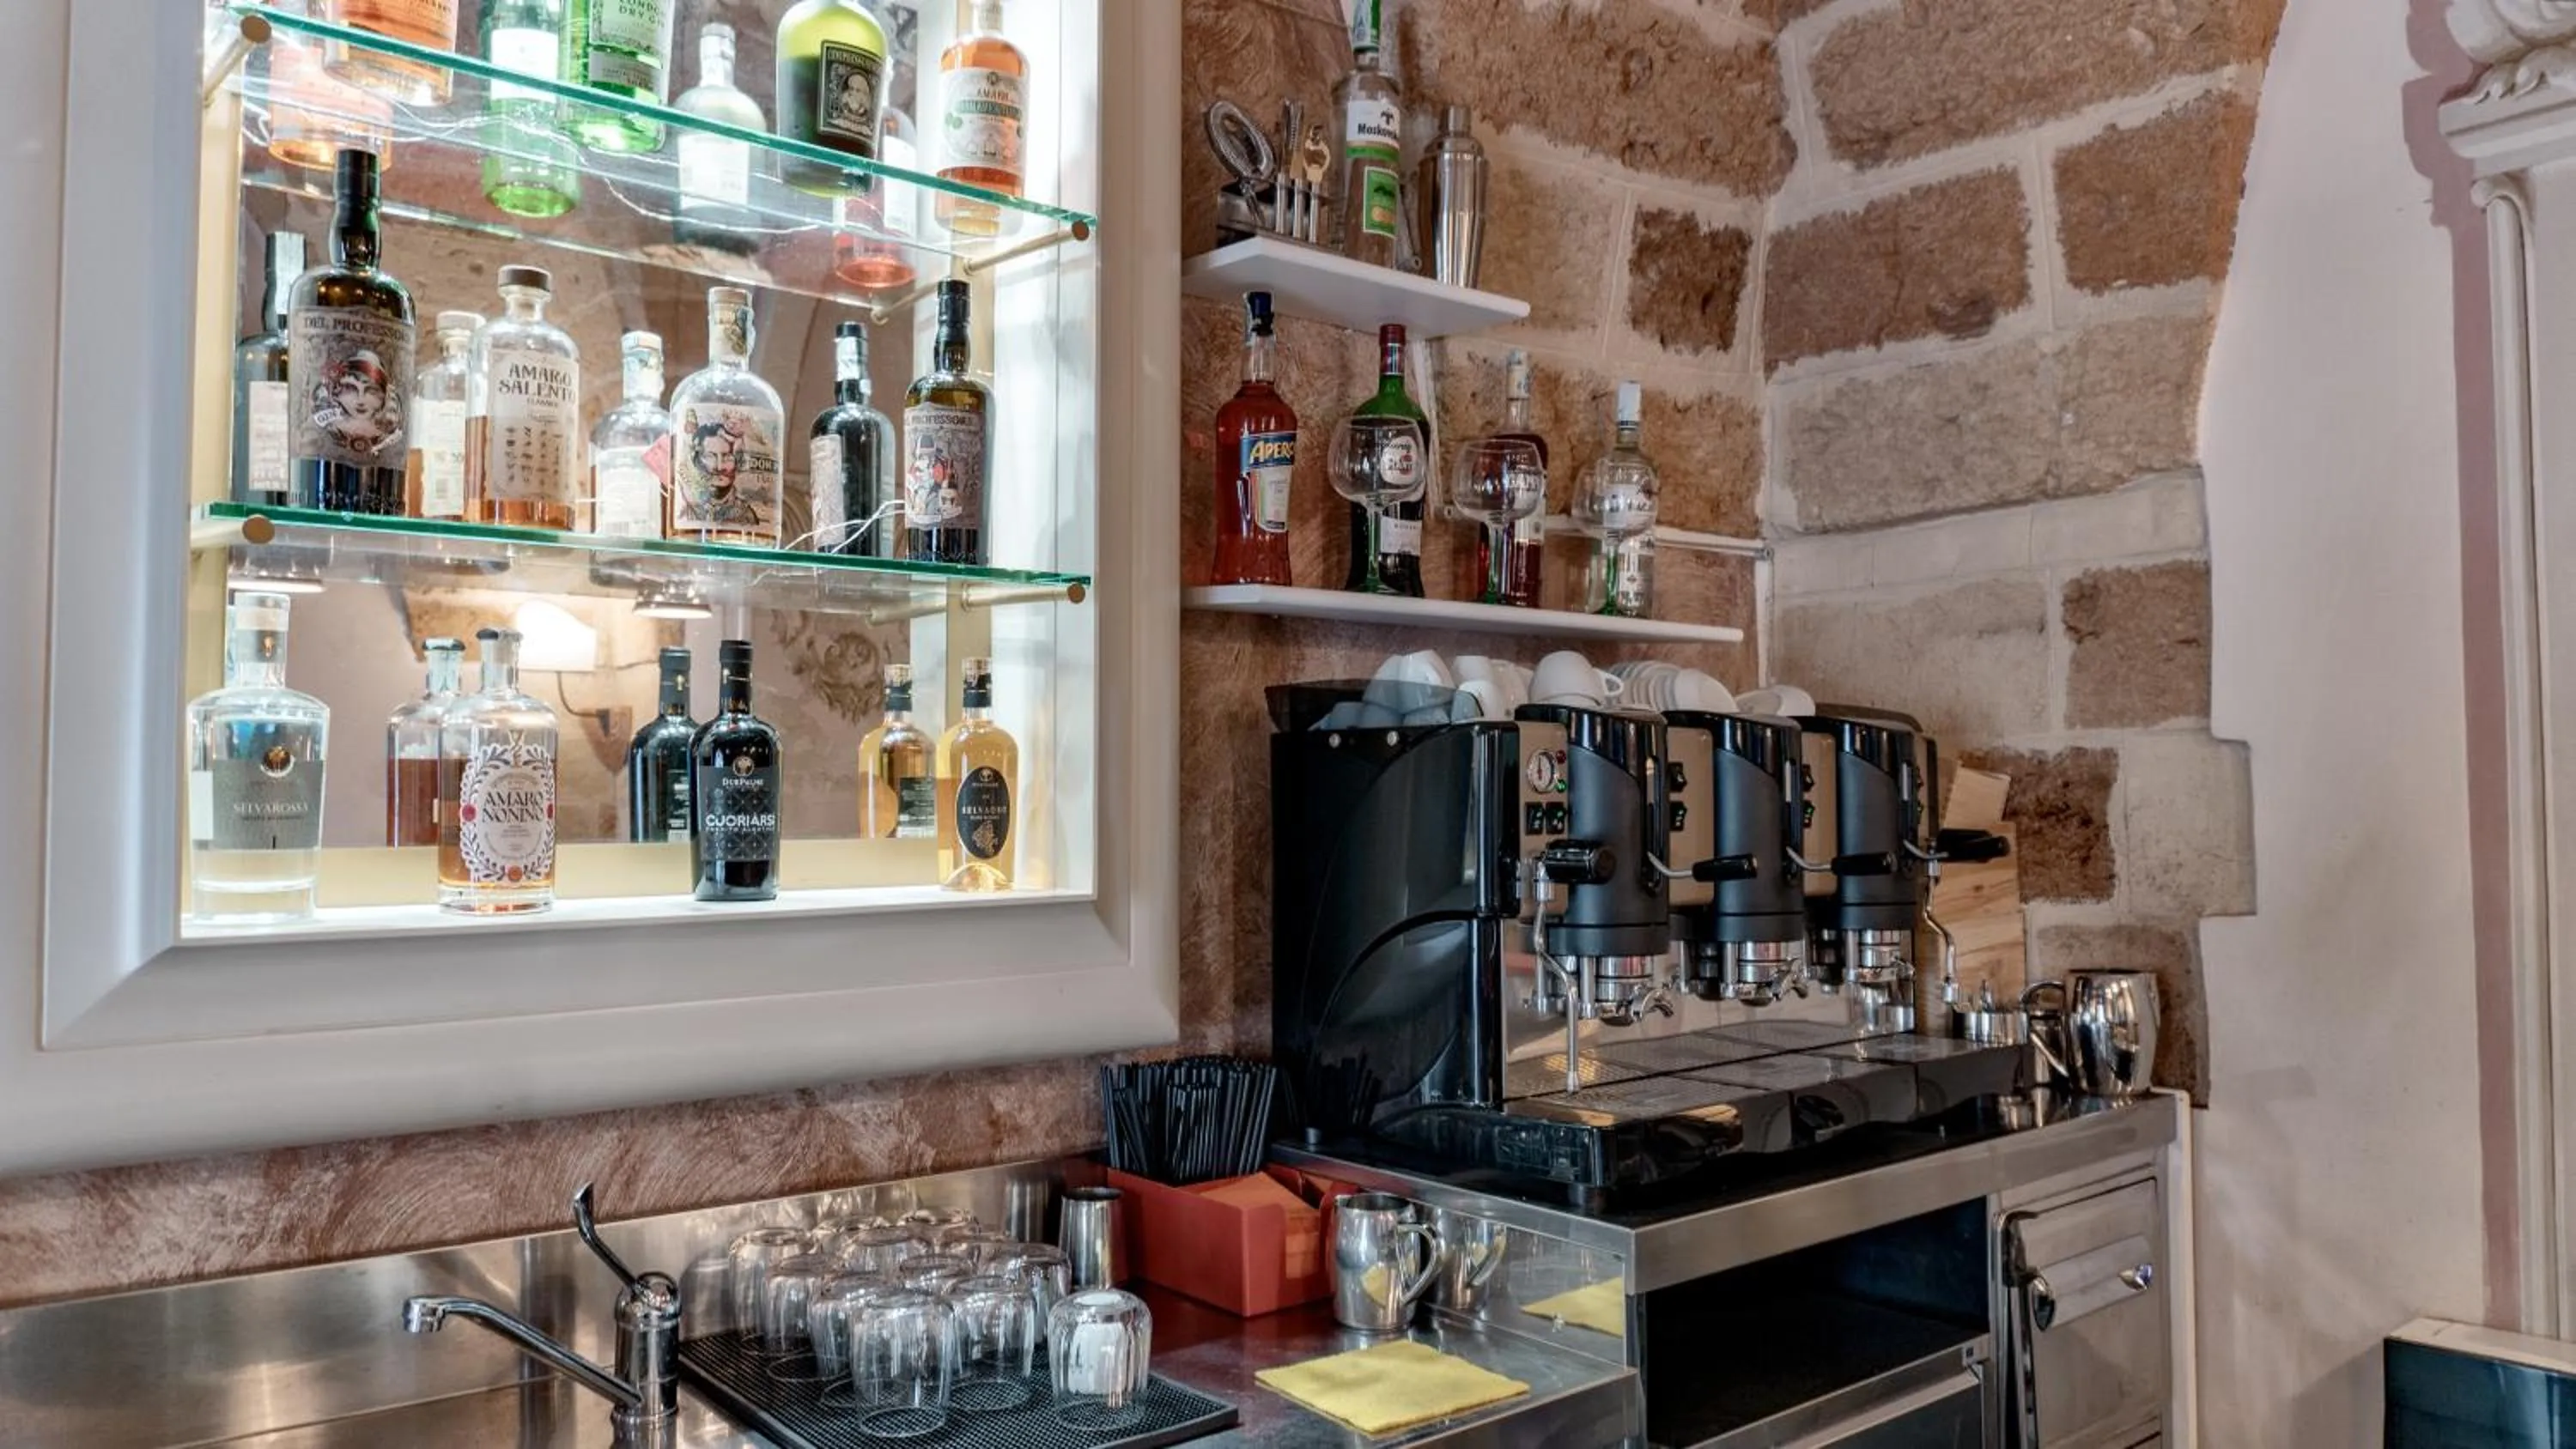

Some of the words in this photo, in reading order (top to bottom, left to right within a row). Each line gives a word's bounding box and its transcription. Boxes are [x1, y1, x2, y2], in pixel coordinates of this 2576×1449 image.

[509, 362, 572, 386] AMARO
[498, 379, 576, 402] SALENTO
[484, 791, 544, 807] AMARO
[482, 806, 544, 823] NONINO
